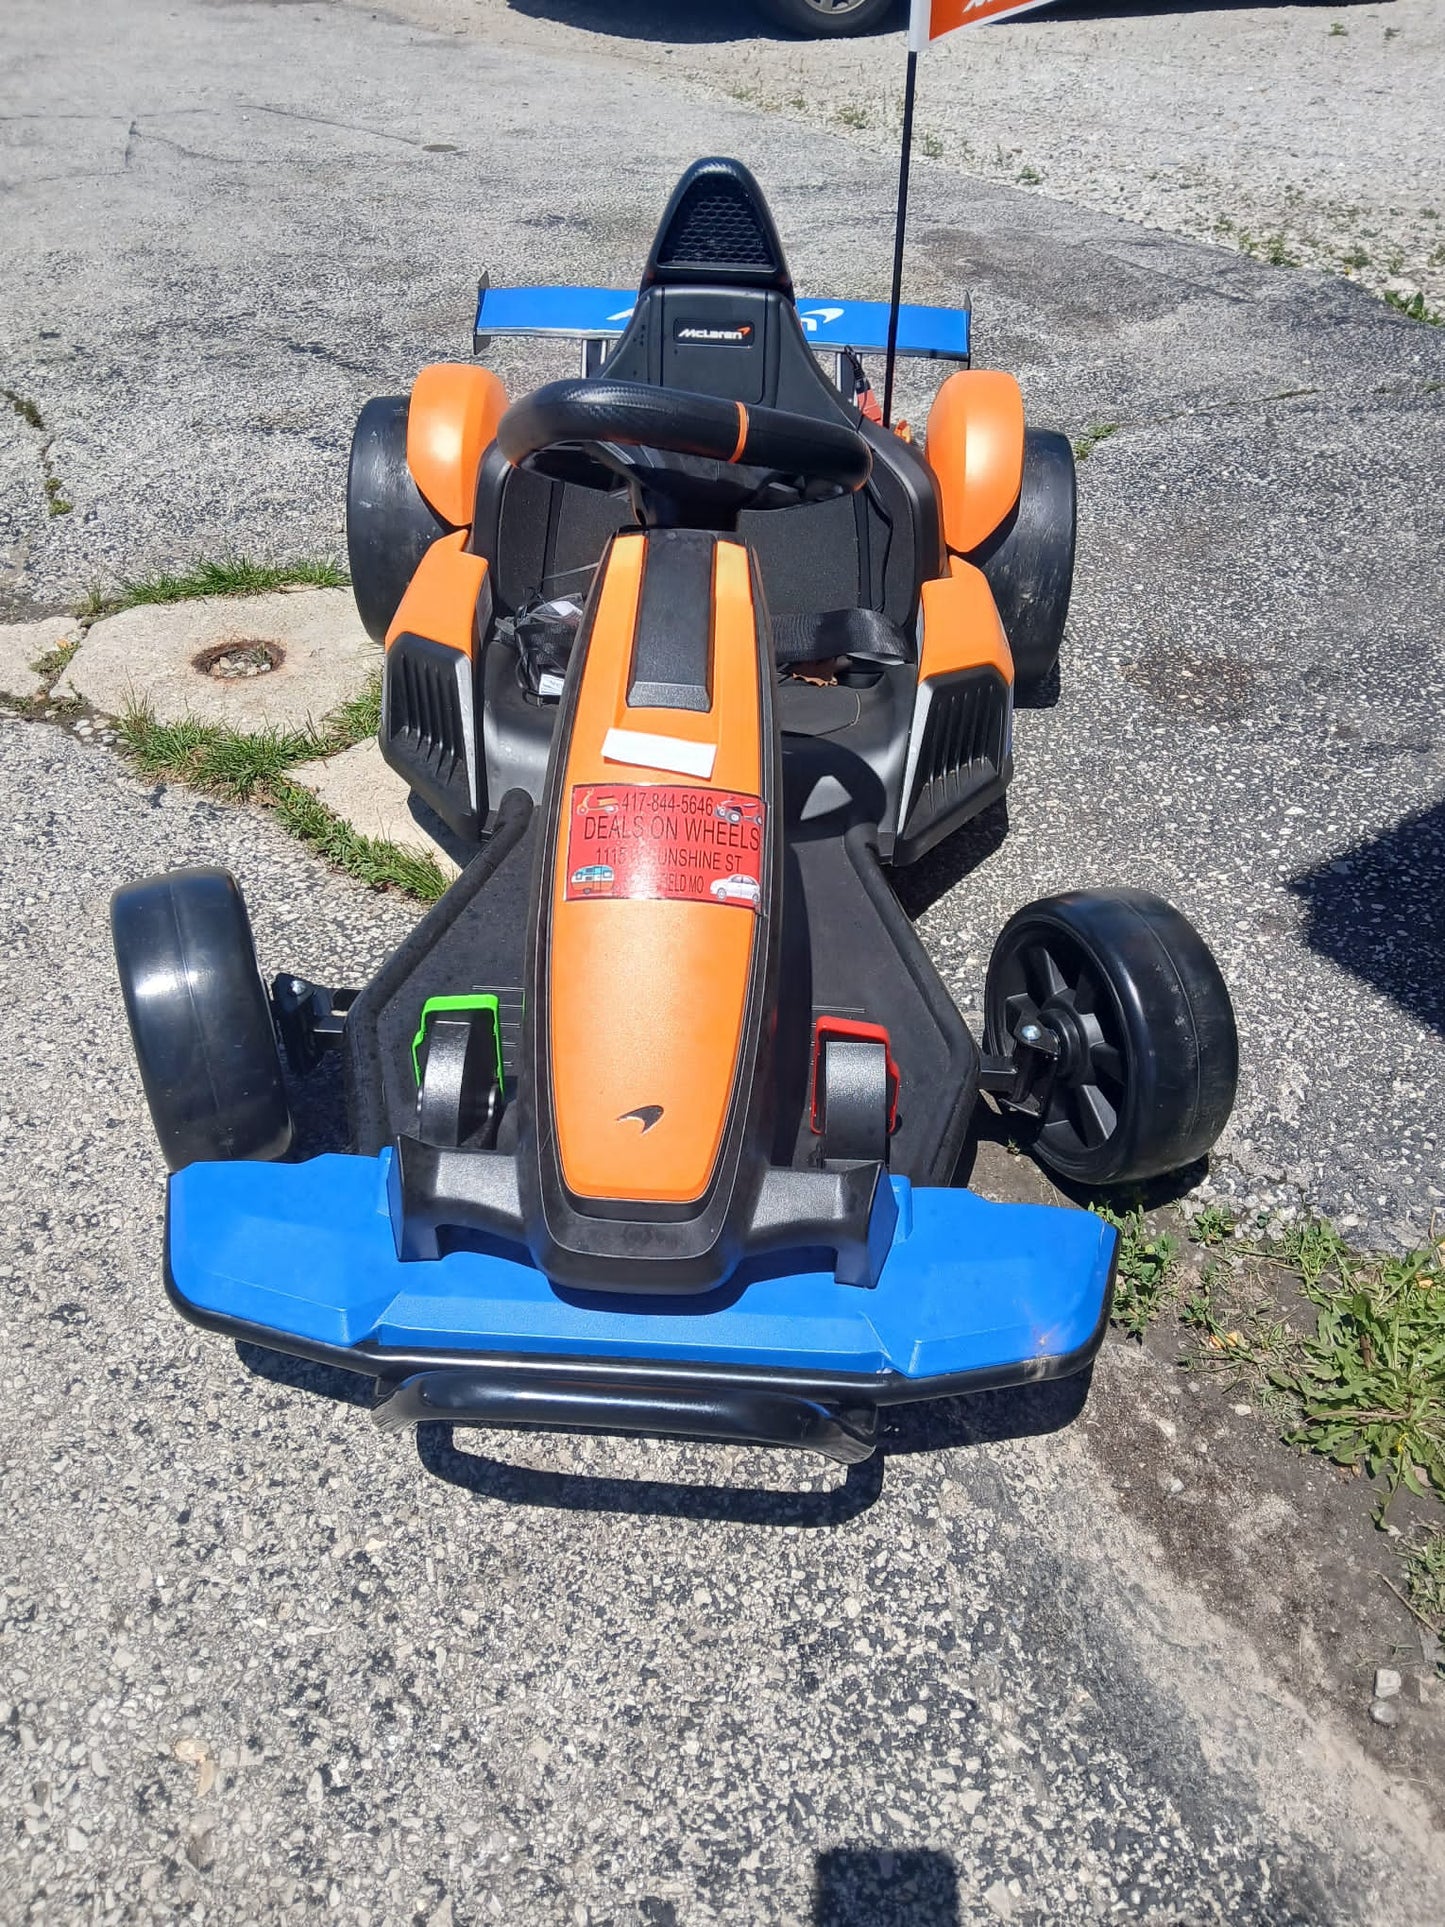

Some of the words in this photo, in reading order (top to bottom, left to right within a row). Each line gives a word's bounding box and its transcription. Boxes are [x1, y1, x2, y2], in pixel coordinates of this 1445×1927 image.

[678, 328, 743, 340] McLaren
[621, 792, 714, 817] 417-844-5646
[584, 815, 644, 840] DEALS
[650, 816, 678, 841] ON
[684, 817, 760, 851] WHEELS
[648, 847, 722, 871] UNSHINE
[724, 853, 743, 874] ST
[688, 875, 705, 894] MO
